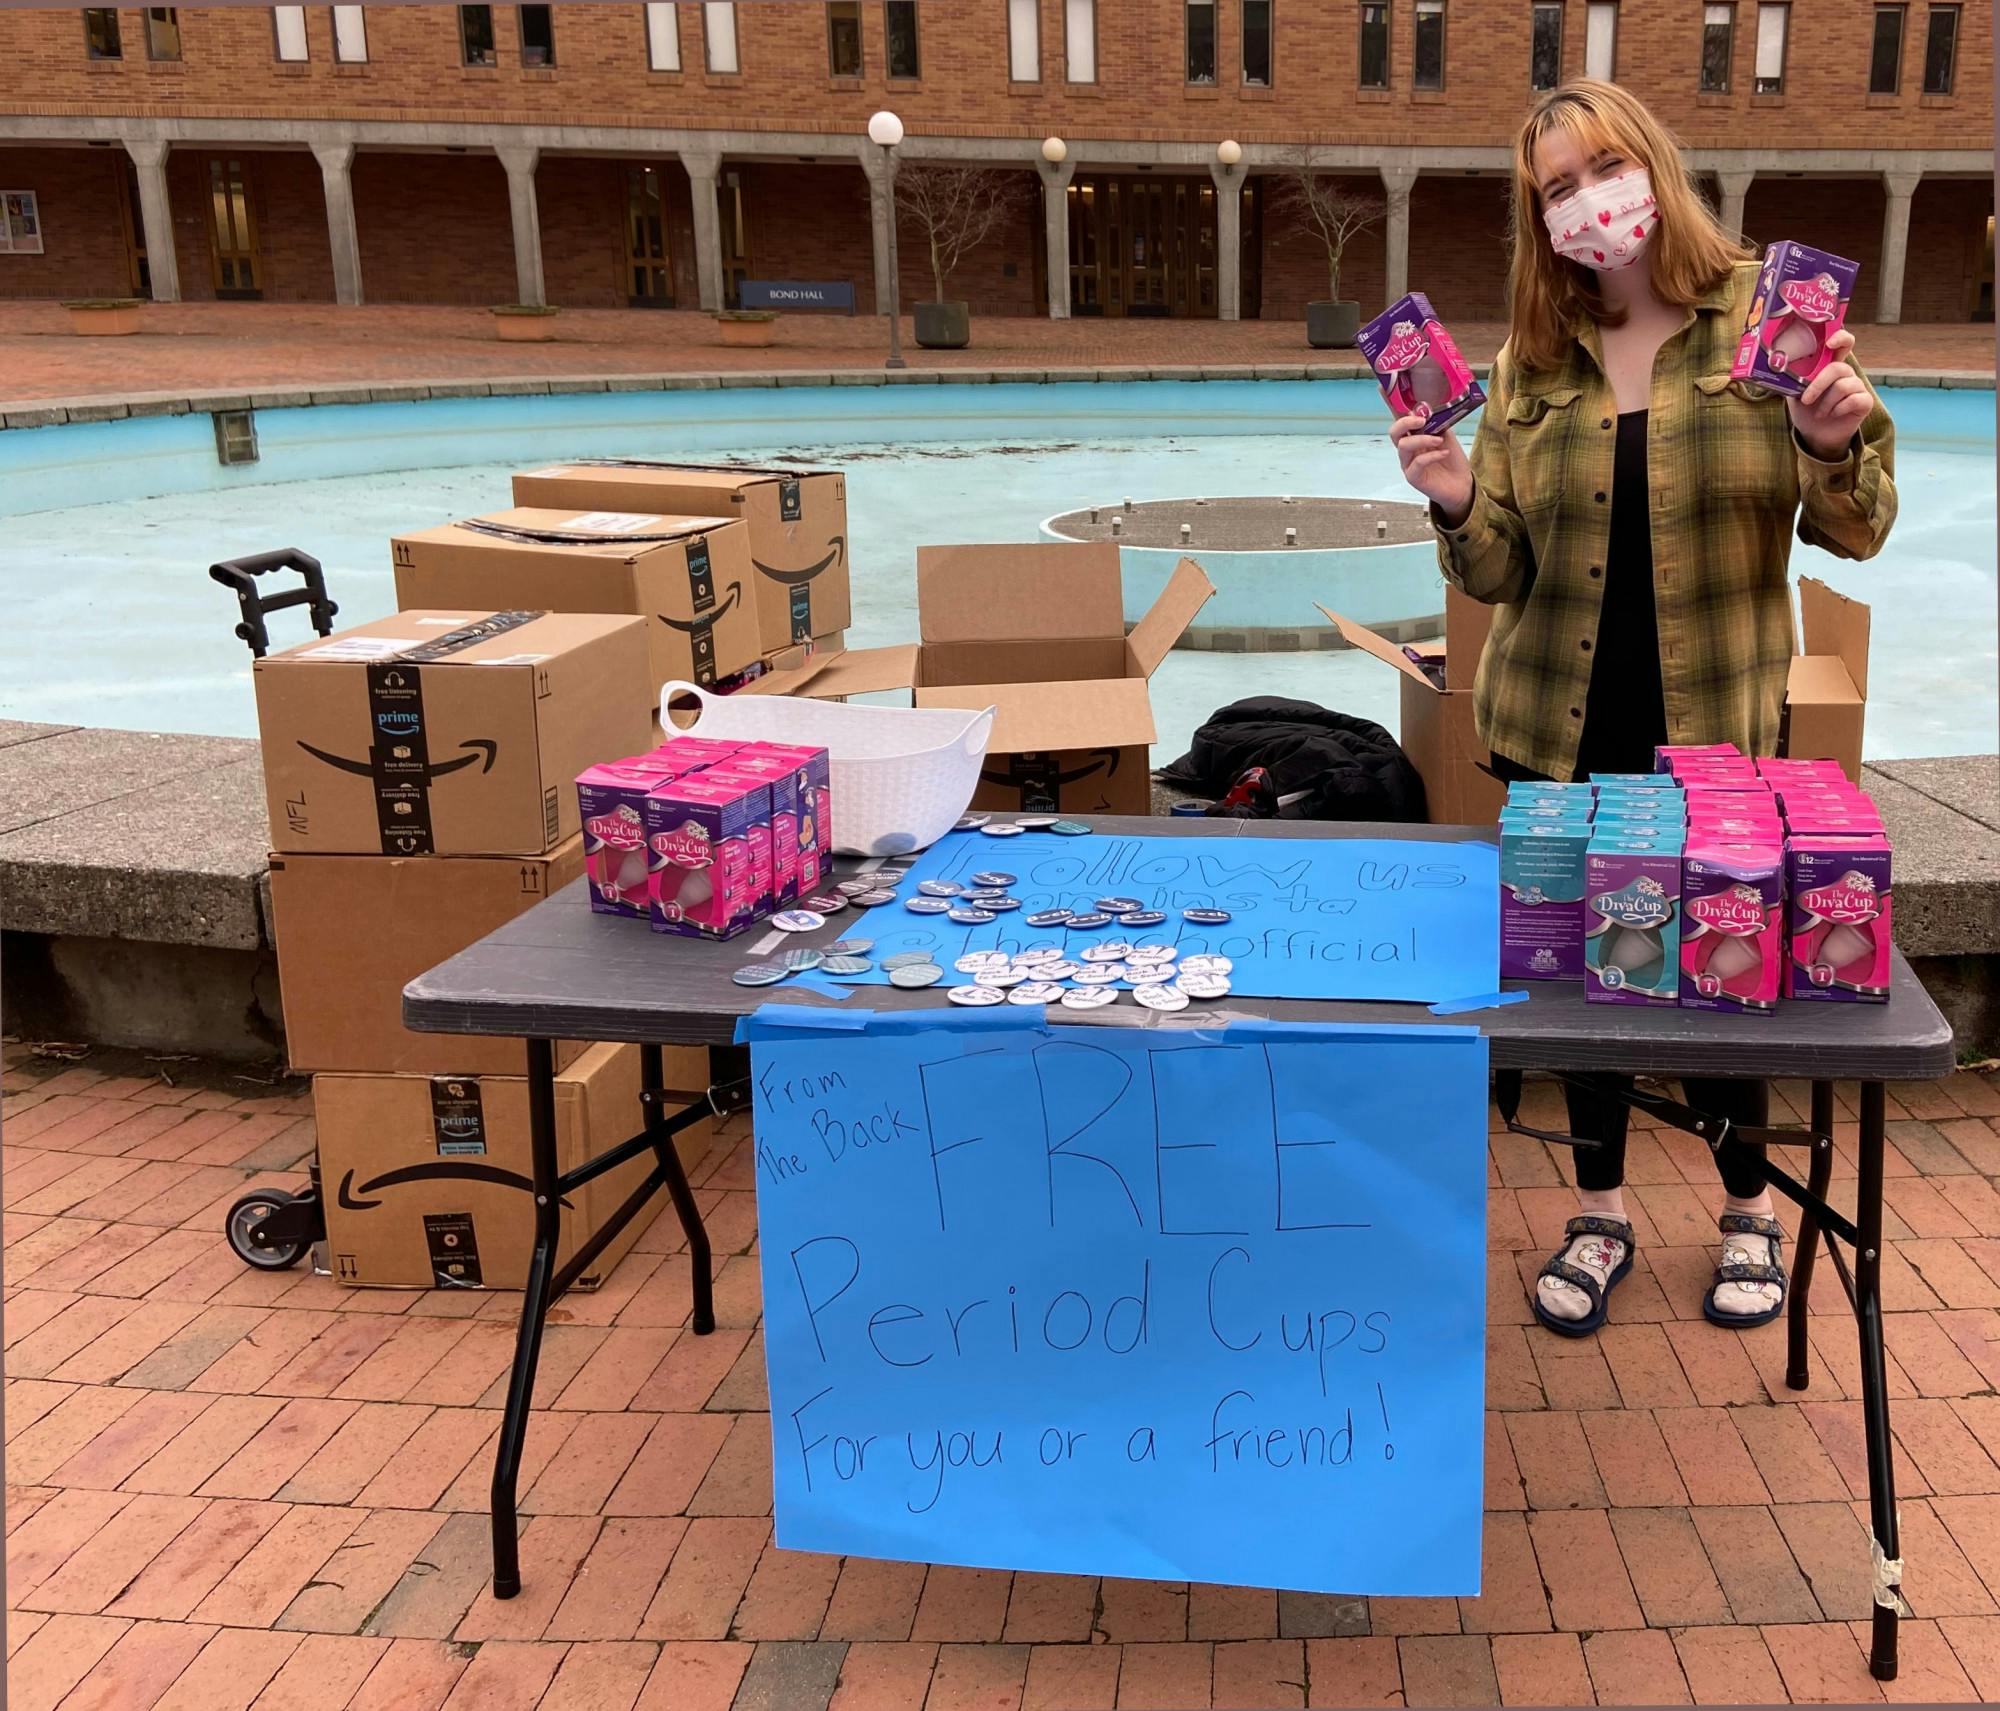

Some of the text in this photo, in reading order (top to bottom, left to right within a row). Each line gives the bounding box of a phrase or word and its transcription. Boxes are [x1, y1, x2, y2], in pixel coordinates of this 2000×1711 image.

[769, 289, 824, 300] BOND HALL
[1785, 283, 1834, 311] DivaCup
[1805, 286, 1815, 295] The
[1378, 334, 1423, 371] DivaCup
[1390, 342, 1401, 353] The
[1774, 357, 1782, 368] 1
[689, 556, 707, 570] prime
[377, 711, 419, 726] prime
[609, 818, 621, 827] The
[590, 820, 642, 840] DivaCup
[675, 835, 686, 844] The
[655, 836, 709, 858] DivaCup
[937, 837, 1467, 892] Follow us
[1597, 860, 1606, 869] 12
[1806, 856, 1814, 864] 12
[1695, 864, 1703, 873] 12
[1151, 883, 1358, 915] insta
[1623, 894, 1634, 902] The
[1832, 889, 1844, 898] The
[1598, 896, 1662, 916] DivaCup
[1720, 898, 1731, 908] The
[1805, 891, 1874, 912] DivaCup
[1694, 900, 1761, 922] DivaCup
[1607, 975, 1617, 985] 2
[1818, 971, 1826, 982] 1
[1705, 982, 1713, 993] 1
[758, 1061, 848, 1114] From
[439, 1114, 479, 1129] prime
[756, 1100, 921, 1186] The Back
[918, 1040, 1372, 1236] FREE
[790, 1236, 1392, 1397] Period Cups
[792, 1386, 876, 1493] For
[907, 1426, 1004, 1514] you
[1039, 1425, 1086, 1465] or
[1126, 1424, 1156, 1462] a
